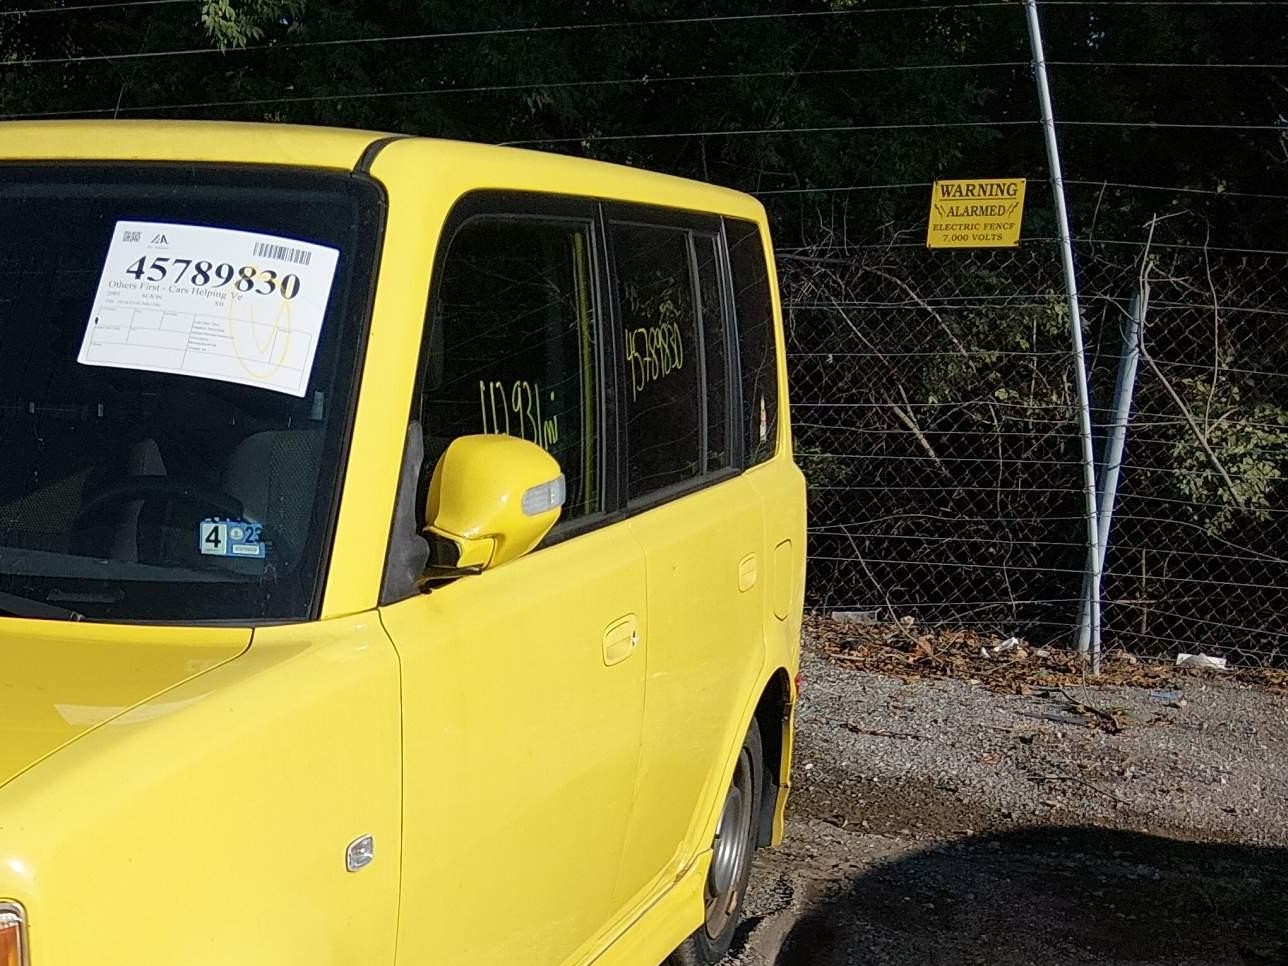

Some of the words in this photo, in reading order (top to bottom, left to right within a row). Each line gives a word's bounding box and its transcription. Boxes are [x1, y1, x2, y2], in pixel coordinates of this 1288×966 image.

[940, 183, 1018, 198] WARNING
[946, 205, 1006, 217] ALARMED
[933, 223, 981, 231] ELECTRIC
[972, 233, 1003, 241] VOLTS
[125, 255, 301, 300] 45789830
[108, 280, 138, 290] Others
[139, 282, 160, 291] First
[168, 285, 189, 294] Cars
[192, 287, 227, 300] Helping
[625, 322, 684, 403] 45789830
[205, 526, 221, 548] 4
